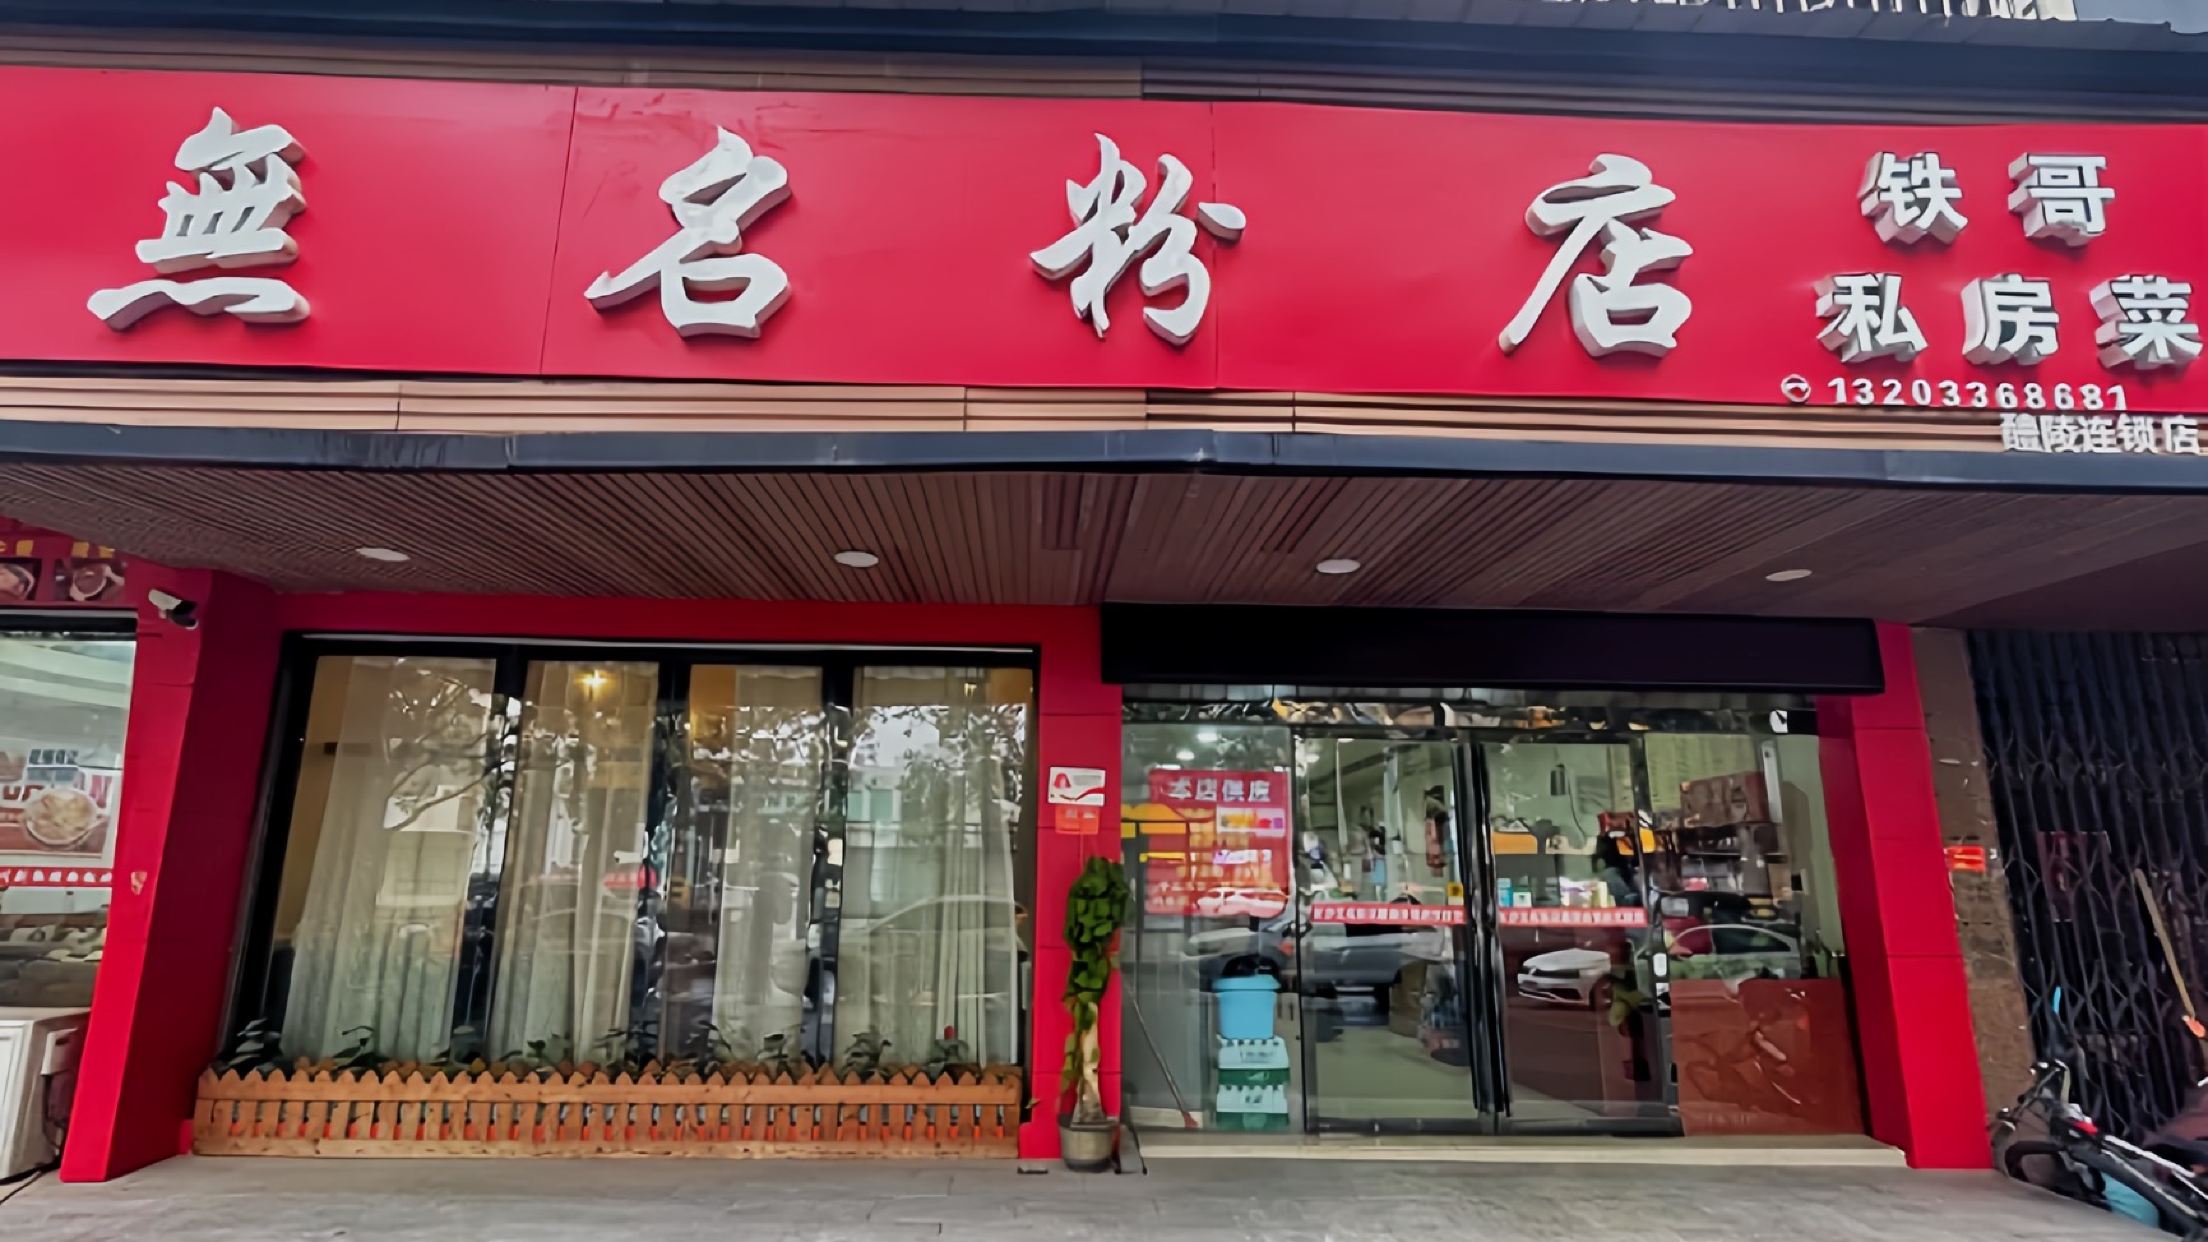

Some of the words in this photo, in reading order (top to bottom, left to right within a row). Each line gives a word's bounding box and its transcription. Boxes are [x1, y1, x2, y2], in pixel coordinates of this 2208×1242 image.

[88, 106, 1693, 357] 無名粉店
[1860, 151, 2115, 246] 铁哥
[1814, 273, 2204, 370] 私房菜
[1827, 377, 2127, 411] 13203368681
